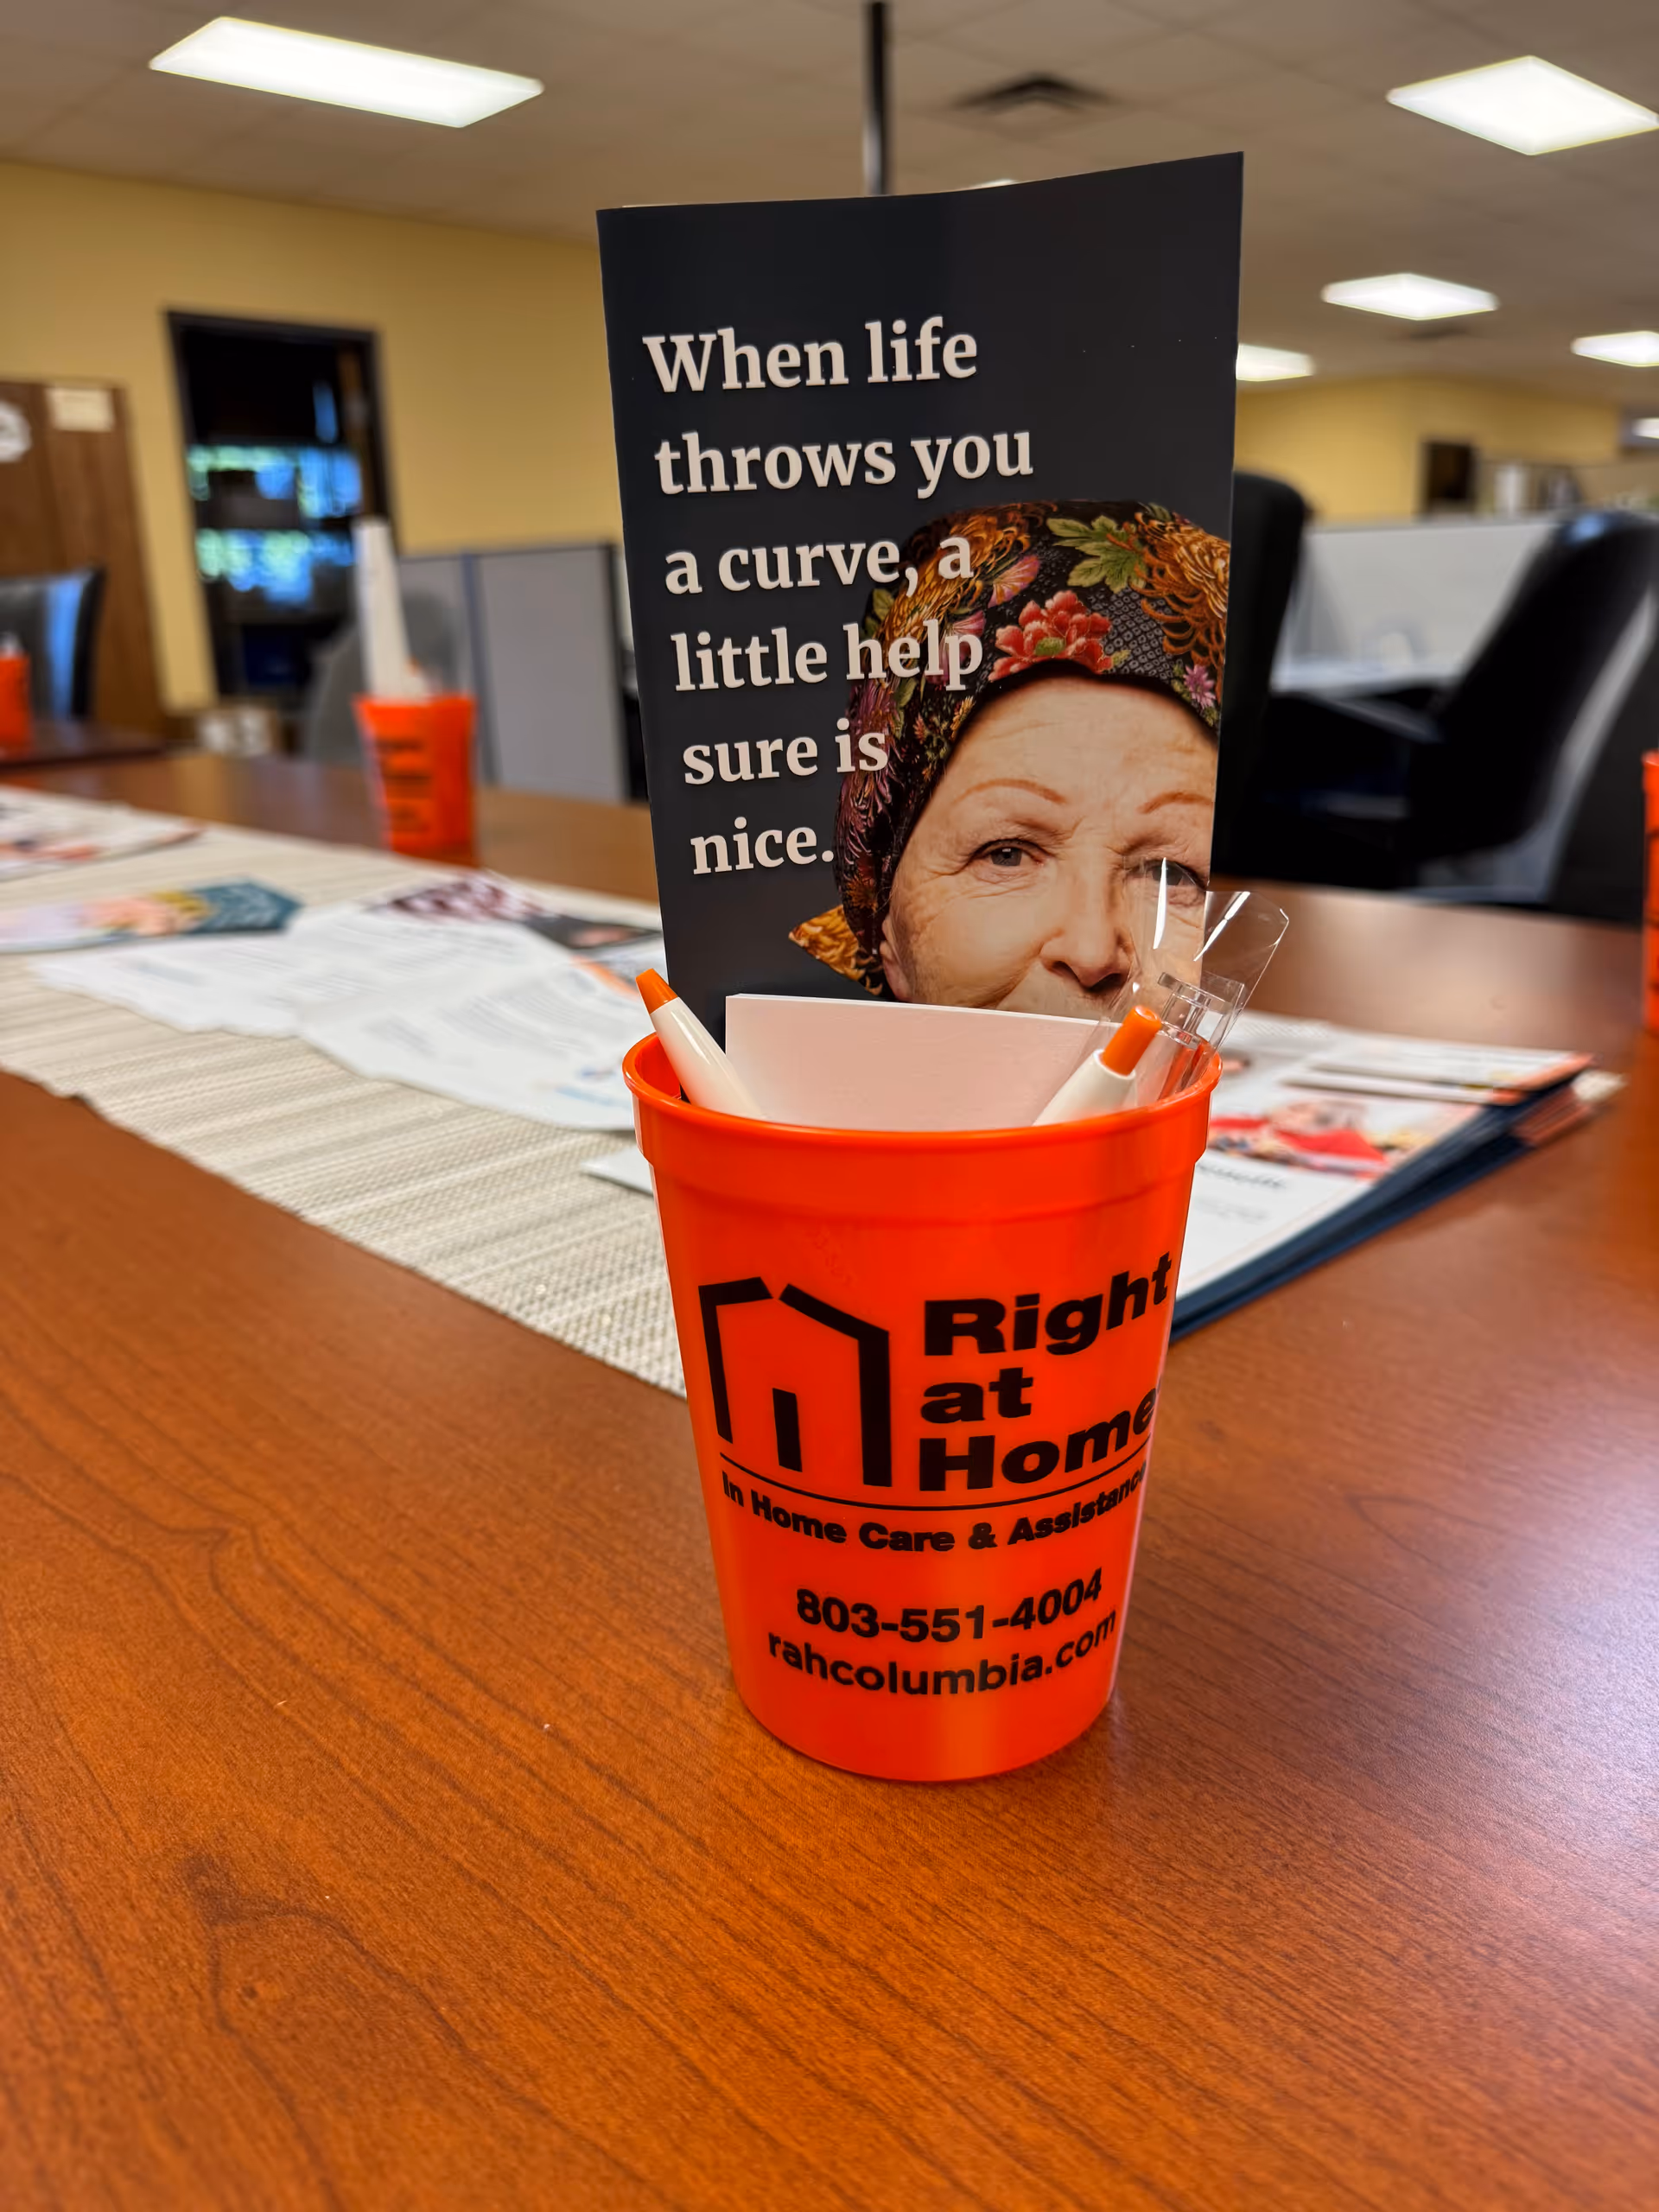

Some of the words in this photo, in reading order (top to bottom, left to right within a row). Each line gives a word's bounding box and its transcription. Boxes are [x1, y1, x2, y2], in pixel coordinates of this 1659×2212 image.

[642, 327, 849, 392] When
[865, 315, 977, 383] life
[655, 430, 896, 494] throws
[911, 429, 1033, 499] you
[665, 550, 702, 594] a
[718, 539, 917, 596] curve,
[938, 536, 973, 580] a
[671, 626, 828, 692] little
[843, 619, 983, 691] help
[683, 734, 817, 785] sure
[835, 717, 888, 773] is
[690, 817, 834, 875] nice.
[924, 1251, 1172, 1356] Right
[920, 1367, 1033, 1424] at
[919, 1388, 1156, 1491] Home
[721, 1471, 744, 1508] In
[752, 1492, 847, 1543] Home
[859, 1522, 956, 1552] Care
[968, 1522, 996, 1549] &
[796, 1567, 1103, 1643] 803-551-4004
[768, 1607, 1116, 1695] rahcolumbia.com
